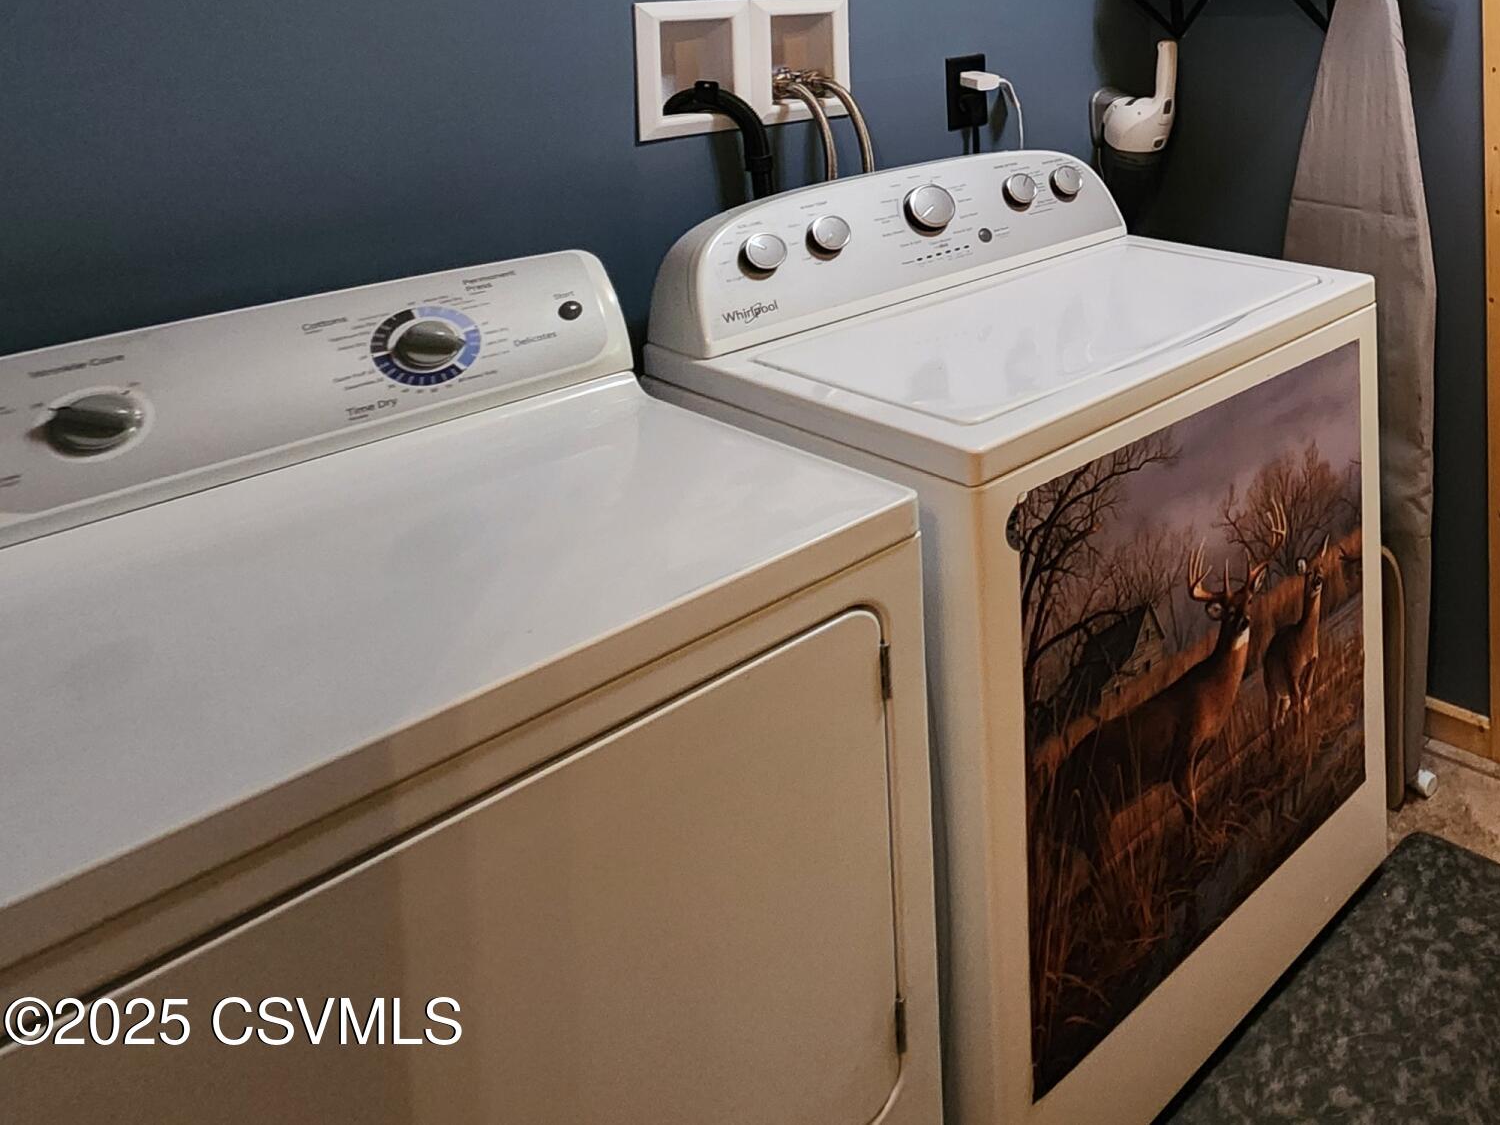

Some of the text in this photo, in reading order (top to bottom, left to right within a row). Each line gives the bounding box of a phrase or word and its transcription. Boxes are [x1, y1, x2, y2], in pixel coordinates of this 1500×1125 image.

[721, 300, 779, 324] Whirlpool
[345, 398, 398, 416] Time Dry
